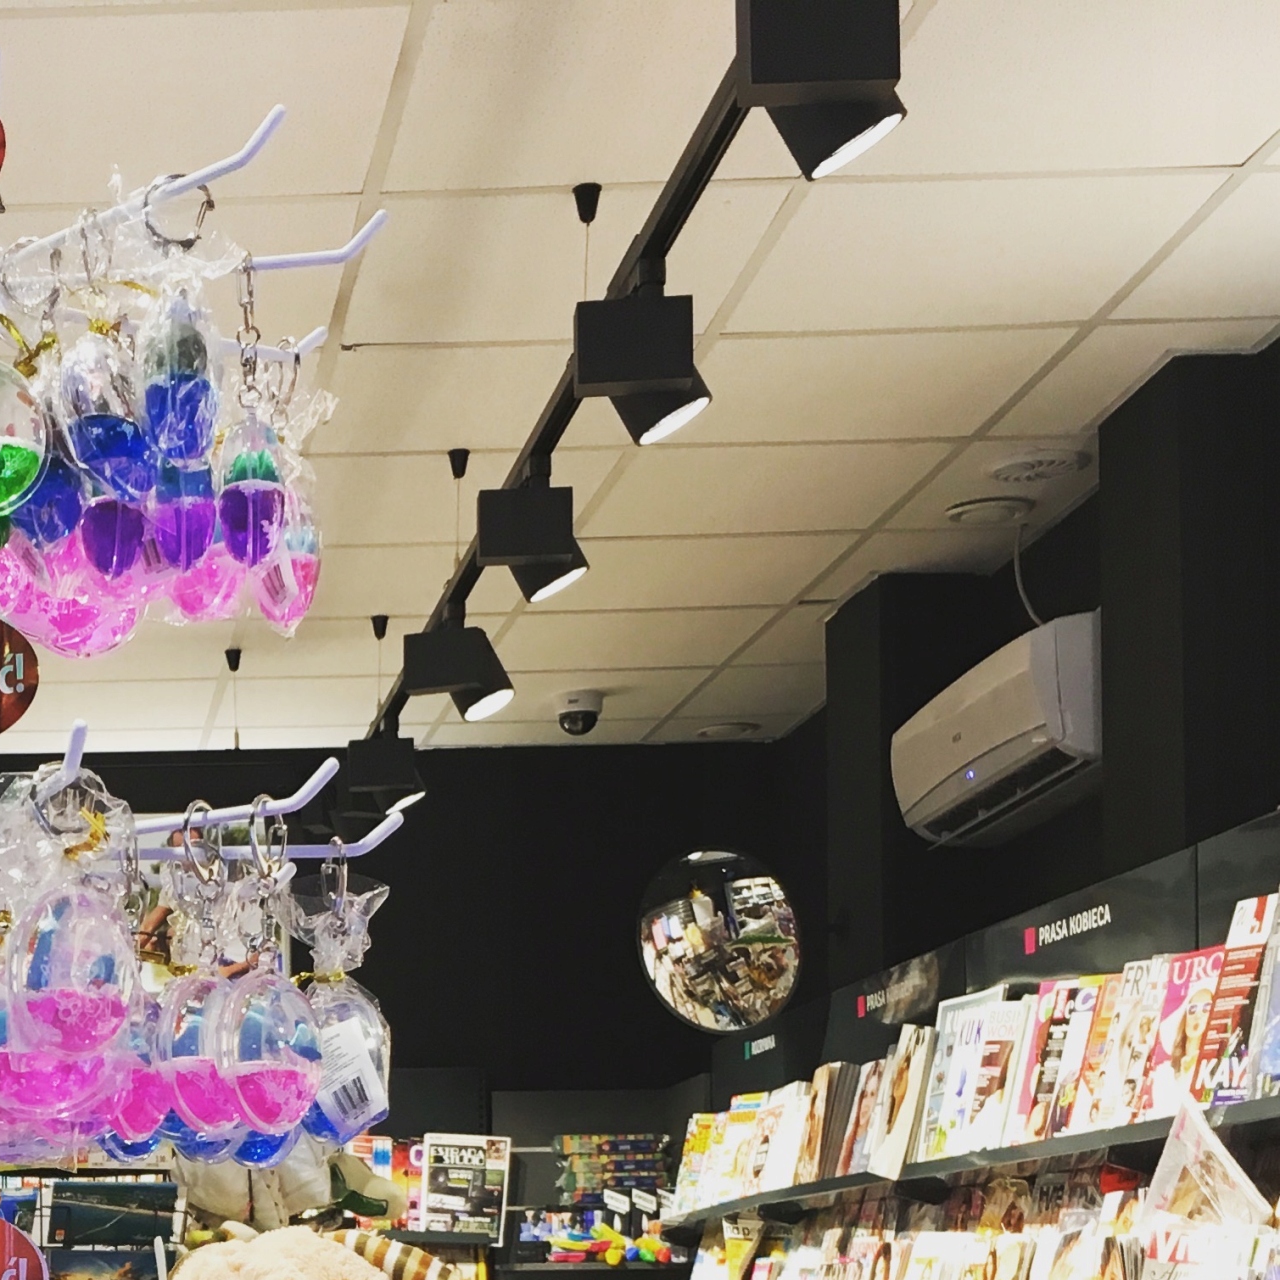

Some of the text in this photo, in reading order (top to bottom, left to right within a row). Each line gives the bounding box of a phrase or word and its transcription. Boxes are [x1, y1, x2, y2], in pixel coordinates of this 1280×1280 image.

[1039, 904, 1112, 947] PRASA KOBIECA
[430, 1147, 485, 1159] ESTRADA
